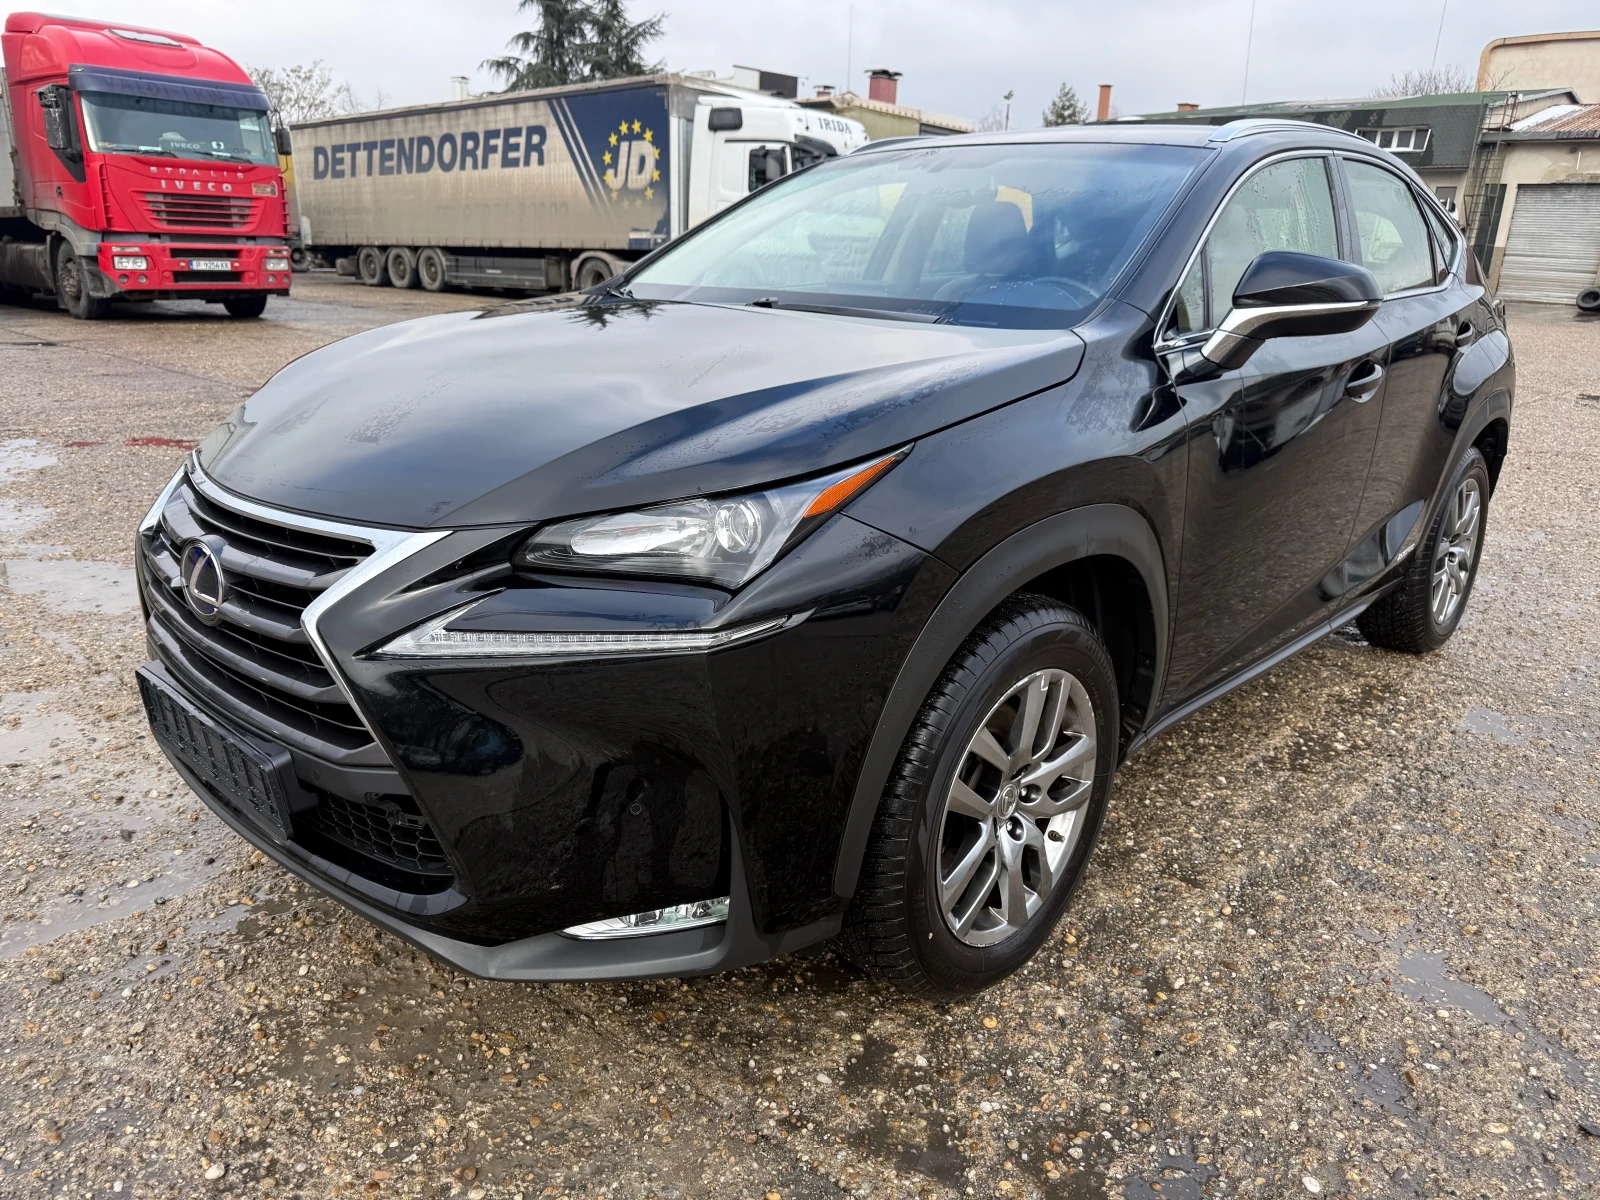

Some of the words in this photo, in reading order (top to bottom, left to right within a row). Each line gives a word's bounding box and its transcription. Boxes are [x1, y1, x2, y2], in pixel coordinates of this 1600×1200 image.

[817, 117, 852, 134] IRIDA
[170, 141, 200, 149] IVECO
[313, 125, 547, 181] DETTENDORFER
[150, 166, 244, 179] STRALIS
[606, 140, 656, 190] JD
[160, 179, 232, 192] IVECO
